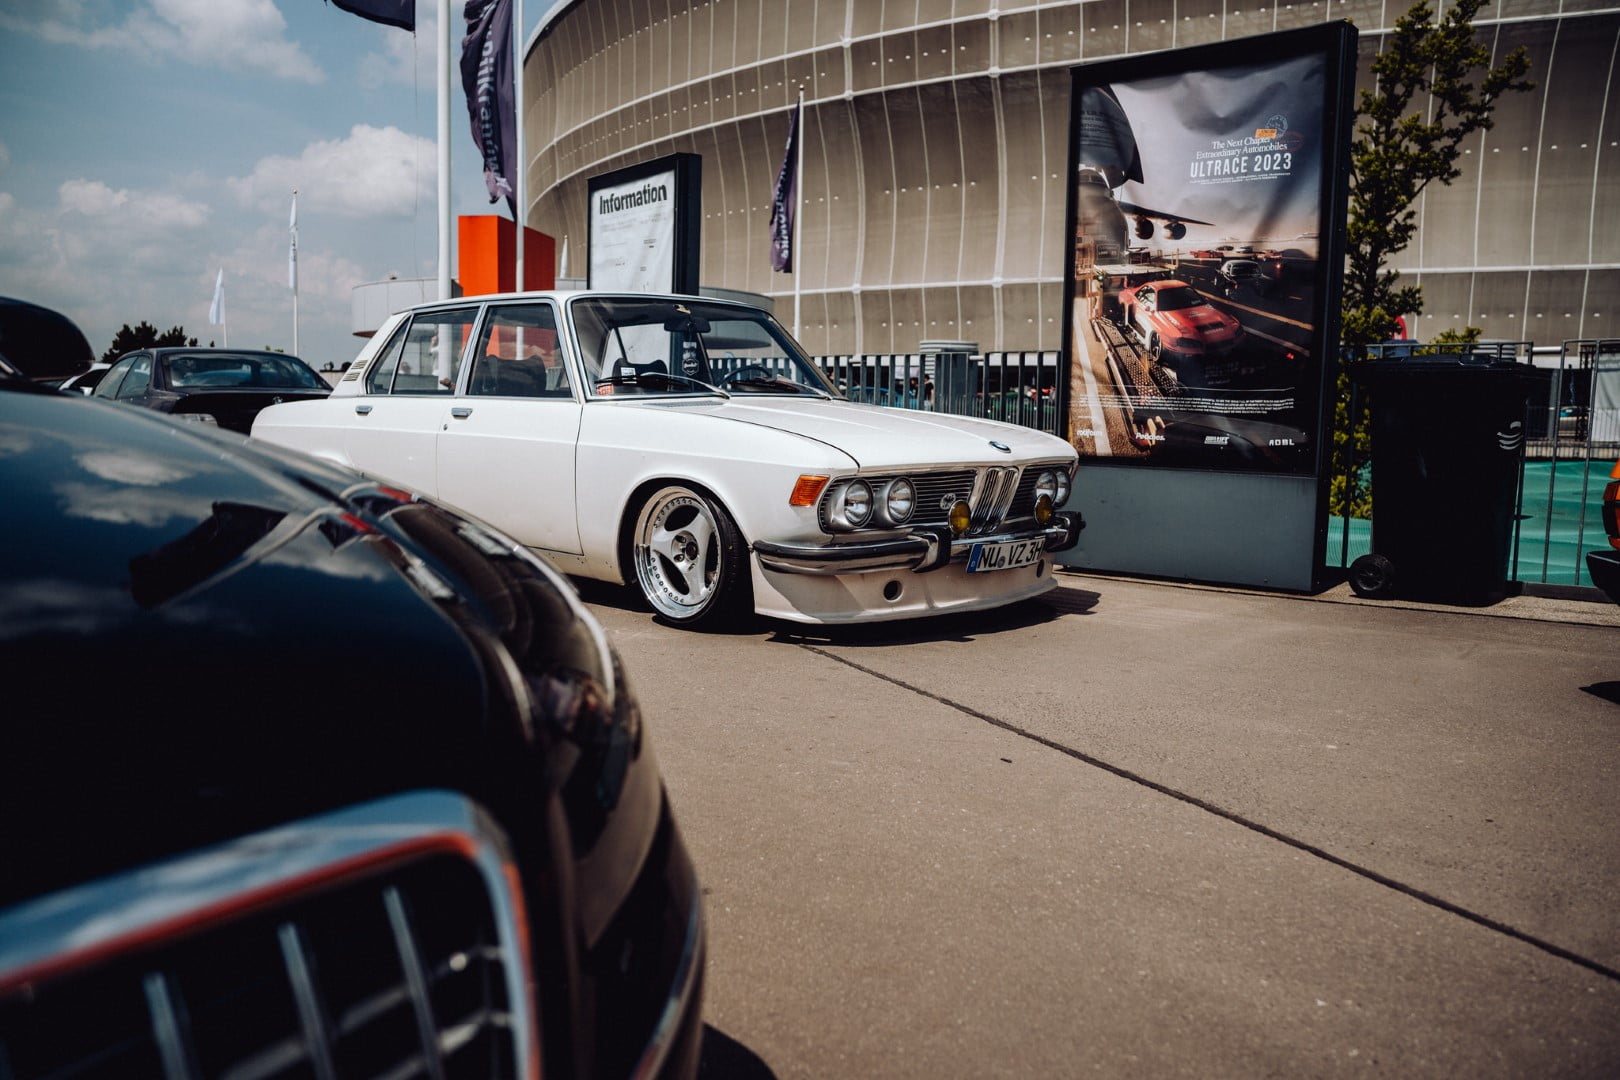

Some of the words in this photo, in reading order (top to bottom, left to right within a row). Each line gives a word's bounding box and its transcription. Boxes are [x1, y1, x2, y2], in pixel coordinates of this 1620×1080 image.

[1196, 148, 1242, 160] Extraordinary
[1243, 142, 1288, 154] Automobiles
[1212, 141, 1225, 150] The
[1226, 138, 1243, 148] Next
[1244, 136, 1271, 147] Chapter
[1190, 156, 1249, 178] ULTRACE
[1253, 152, 1293, 172] 2023
[599, 183, 667, 215] Information
[977, 546, 1002, 569] NU
[1008, 543, 1027, 566] VZ
[1026, 540, 1044, 562] 3H
